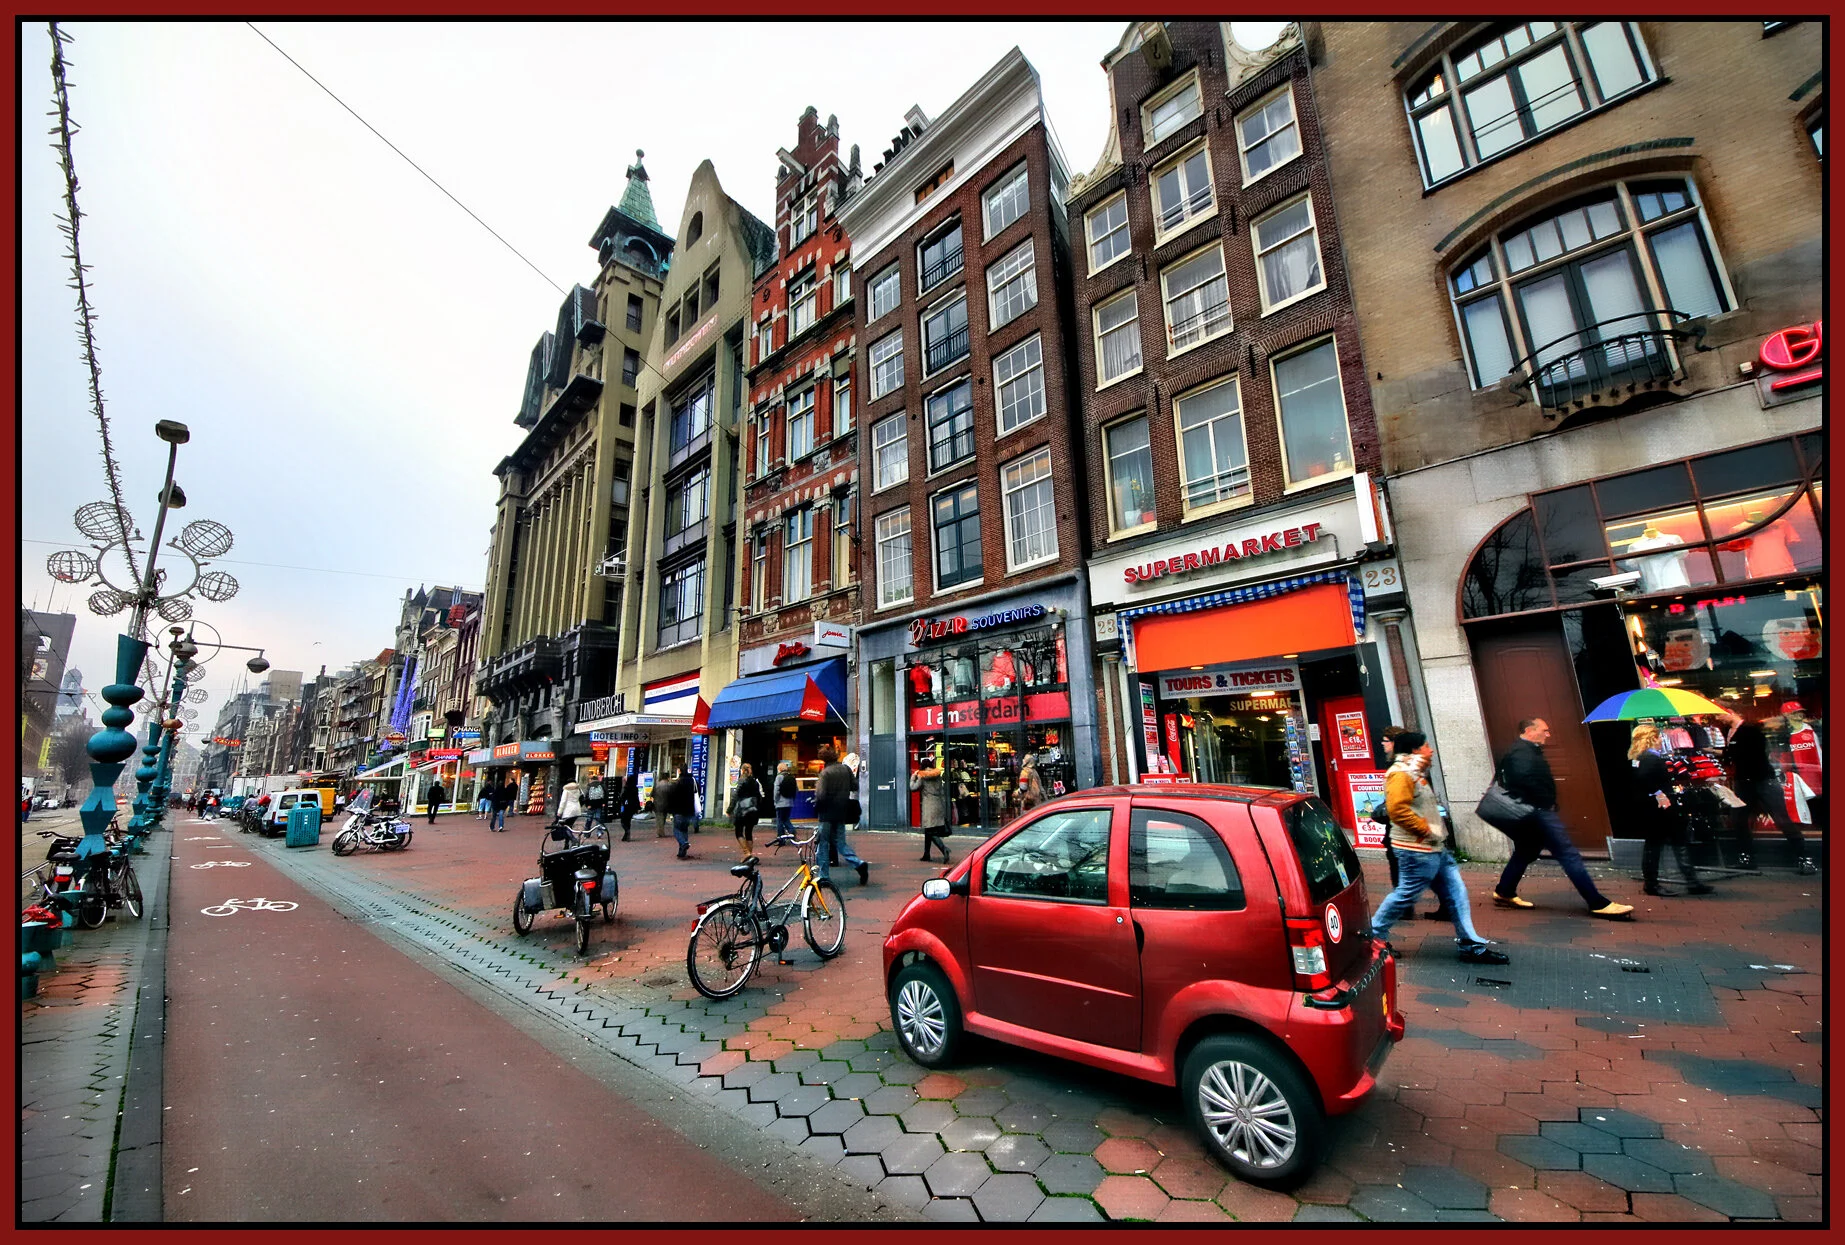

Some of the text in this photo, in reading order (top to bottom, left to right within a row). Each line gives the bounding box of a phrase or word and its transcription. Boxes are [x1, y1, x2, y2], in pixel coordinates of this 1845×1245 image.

[1124, 523, 1321, 583] SUPERMARKET
[1365, 567, 1397, 588] 23
[909, 604, 1044, 647] BAZAR SOUVENIRS
[1097, 619, 1116, 634] 23
[1165, 668, 1295, 691] TOURS & TICKETS
[579, 693, 625, 721] LINDBERGH
[926, 708, 933, 725] I
[1330, 916, 1339, 931] 40
